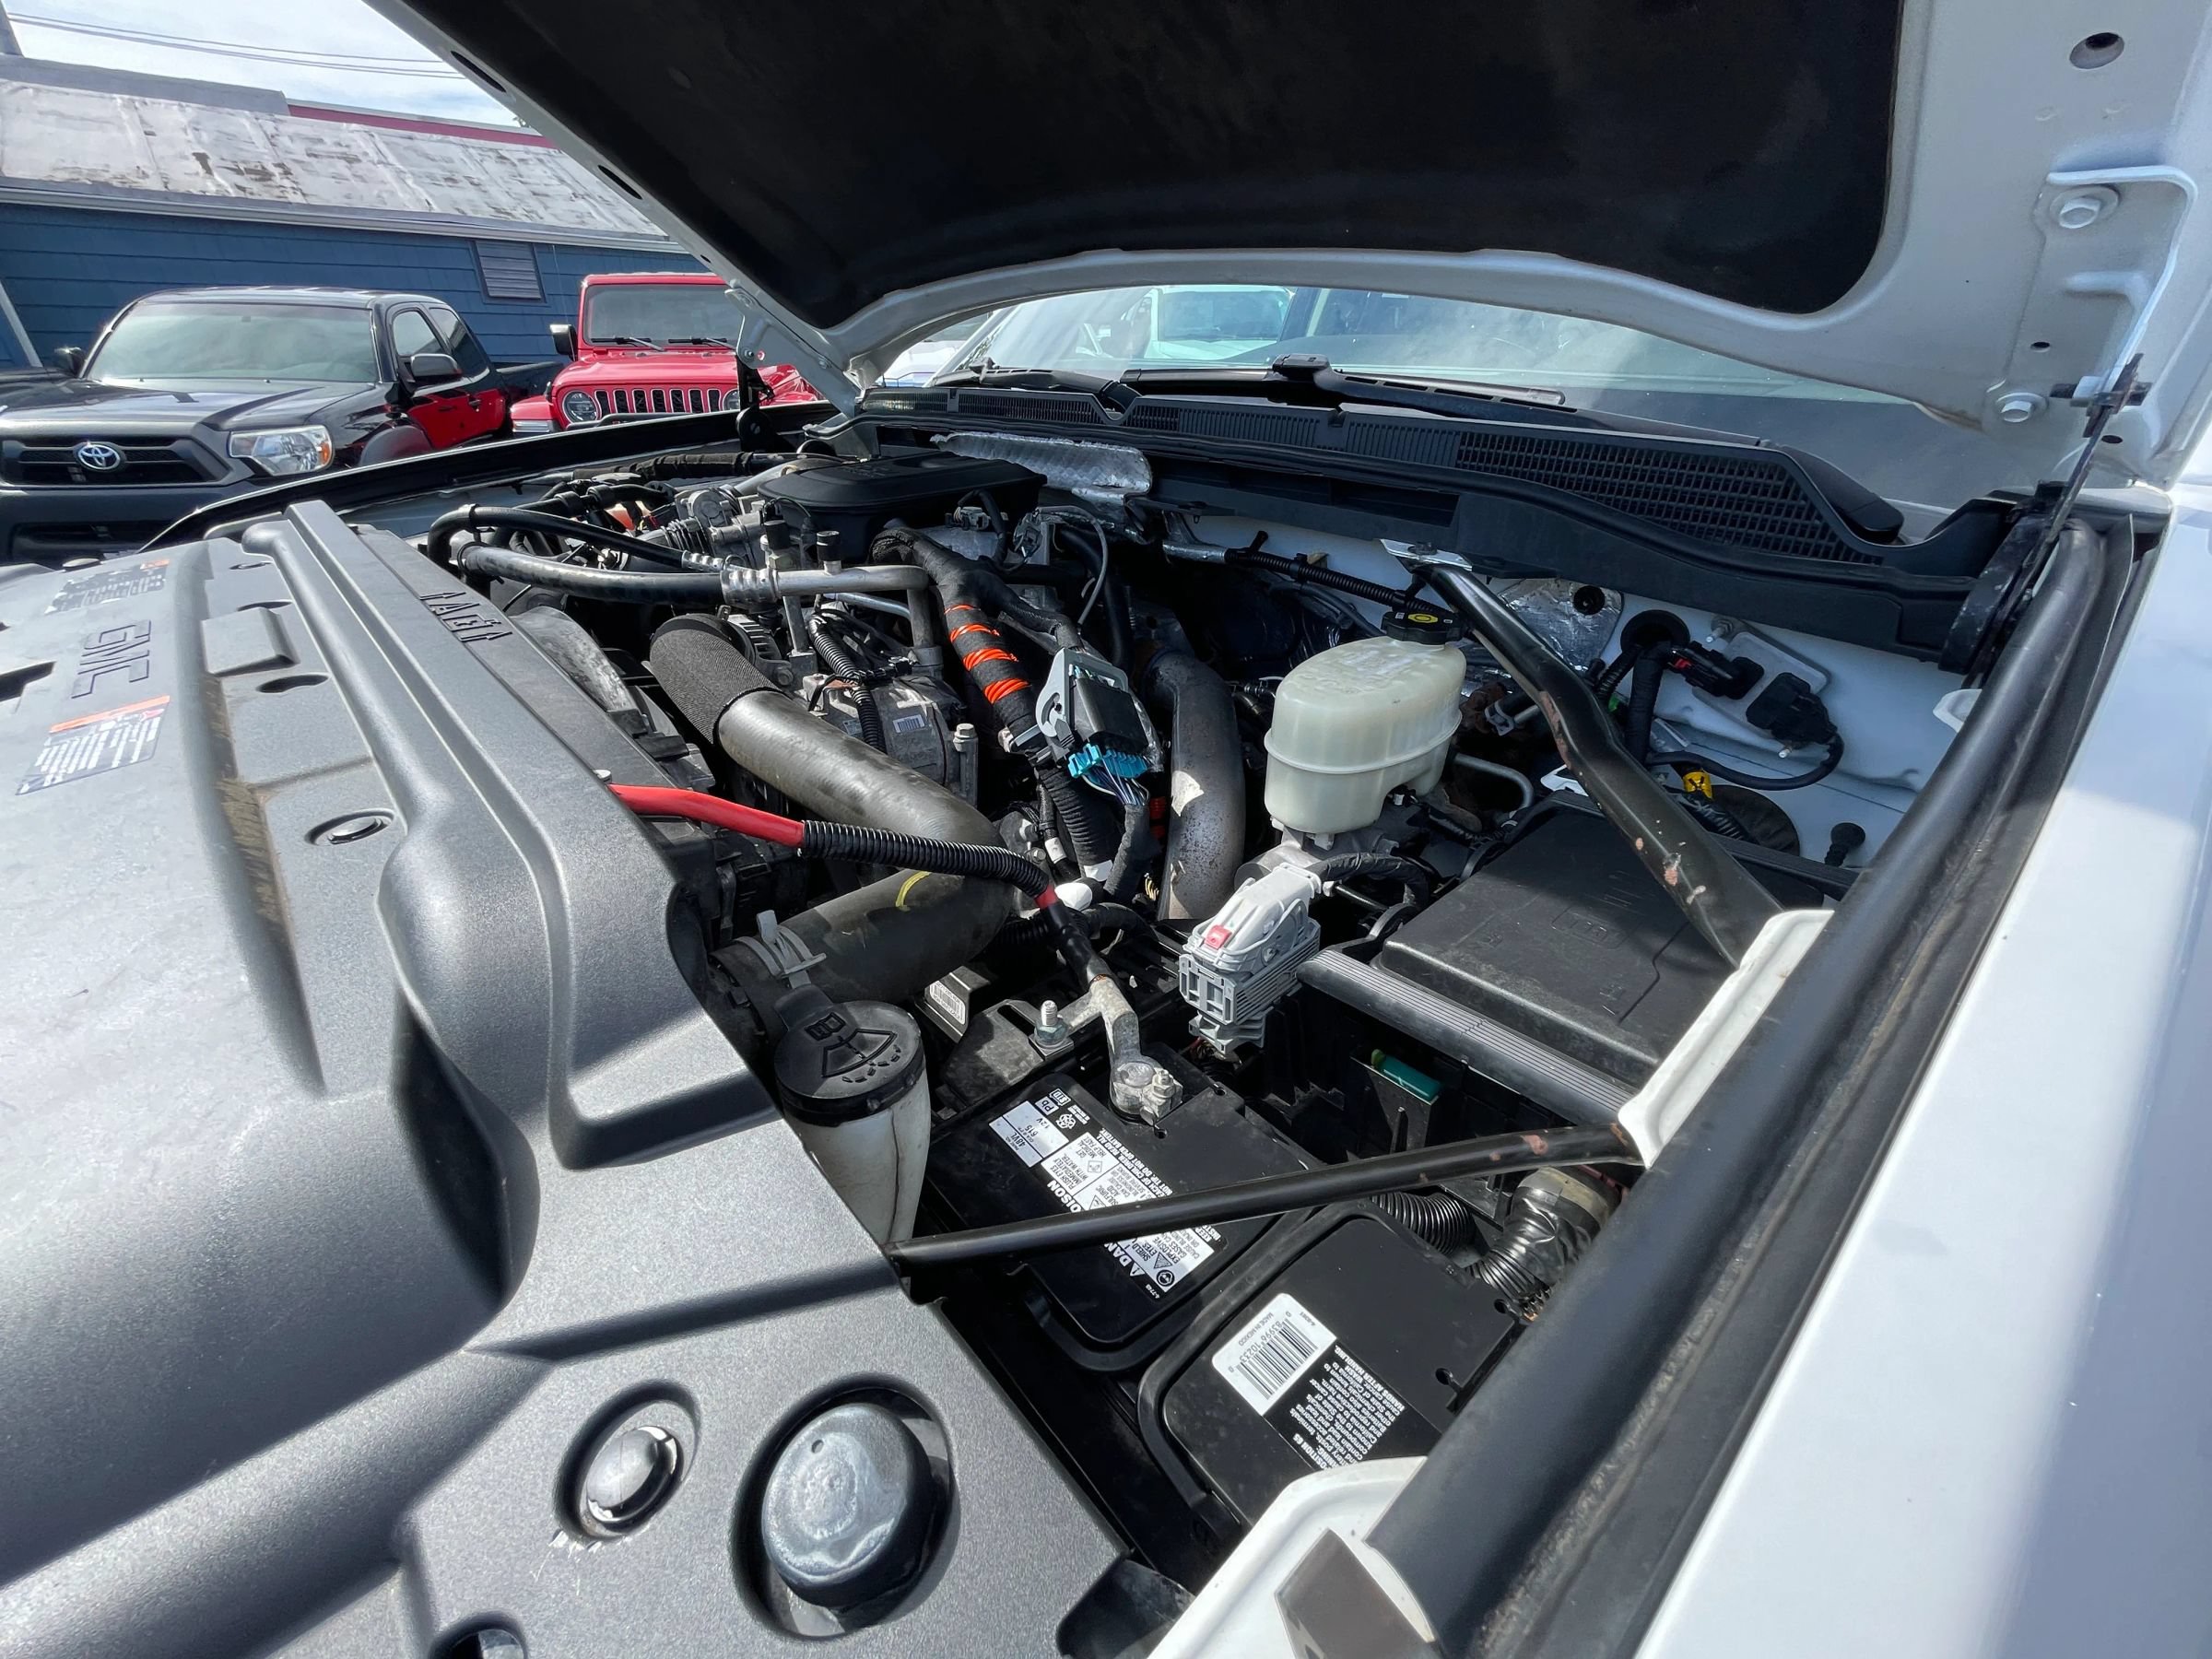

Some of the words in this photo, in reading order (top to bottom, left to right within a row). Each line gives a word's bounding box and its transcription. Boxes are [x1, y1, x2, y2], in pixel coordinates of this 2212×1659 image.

[70, 619, 152, 699] GMC
[1038, 1099, 1054, 1112] Pb
[1008, 1131, 1027, 1147] 48VL
[1094, 1133, 1108, 1145] ALL
[1075, 1147, 1088, 1159] GET
[1076, 1139, 1099, 1159] MEDICAL
[1092, 1145, 1107, 1158] HELP
[1103, 1141, 1120, 1156] READ
[1117, 1145, 1135, 1159] OPEN
[1049, 1164, 1063, 1177] EYES
[1053, 1157, 1082, 1185] IMMEDIATELY
[1130, 1157, 1146, 1170] NOT
[1141, 1166, 1153, 1177] DO
[1059, 1174, 1077, 1190] FLUSH
[1074, 1167, 1088, 1181] WITH
[1107, 1175, 1124, 1190] CAUSE
[1140, 1175, 1152, 1185] OF
[1105, 1183, 1121, 1197] ACID
[1115, 1174, 1140, 1196] BLINDNESS
[1118, 1186, 1132, 1198] CAN
[1127, 1177, 1146, 1194] SEVERE
[1147, 1182, 1166, 1198] EACH
[1158, 1182, 1174, 1195] NOT
[1045, 1178, 1083, 1215] OISON
[1102, 1238, 1133, 1267] DAN
[1130, 1241, 1151, 1262] SHIELD
[1151, 1235, 1182, 1265] EXPLOSIVE
[1167, 1240, 1187, 1258] GASES
[1182, 1242, 1200, 1260] CAUSE
[1258, 1312, 1274, 1326] MADE
[1237, 1327, 1257, 1347] MEXICO
[1259, 1320, 1283, 1343] 83996
[1238, 1340, 1262, 1364] 10233
[1322, 1361, 1332, 1371] to
[1343, 1364, 1364, 1383] WASH
[1308, 1377, 1329, 1397] cancer
[1327, 1376, 1351, 1398] contain
[1328, 1368, 1349, 1388] known
[1336, 1366, 1366, 1393] California
[1361, 1371, 1384, 1392] AFTER
[1313, 1392, 1324, 1402] of
[1325, 1394, 1345, 1412] cause
[1345, 1384, 1376, 1413] chemicals
[1347, 1394, 1363, 1409] also
[1367, 1395, 1387, 1413] State
[1380, 1388, 1406, 1412] HANDS
[1304, 1393, 1335, 1422] chemicals
[1304, 1403, 1320, 1418] lead
[1320, 1398, 1338, 1416] State
[1334, 1391, 1372, 1428] reproductive
[1341, 1409, 1352, 1419] to
[1380, 1396, 1402, 1417] cause
[1382, 1409, 1397, 1422] the
[1288, 1406, 1317, 1435] terminals
[1294, 1403, 1328, 1436] accessories
[1315, 1415, 1331, 1429] and
[1334, 1412, 1347, 1425] the
[1343, 1421, 1354, 1430] to
[1359, 1406, 1388, 1433] Batteries
[1371, 1409, 1393, 1428] other
[1291, 1431, 1304, 1445] 65
[1326, 1425, 1343, 1441] lead
[1347, 1415, 1379, 1444] California
[1366, 1423, 1383, 1439] and
[1324, 1433, 1347, 1455] related
[1349, 1428, 1374, 1450] known
[1338, 1437, 1364, 1461] contain
